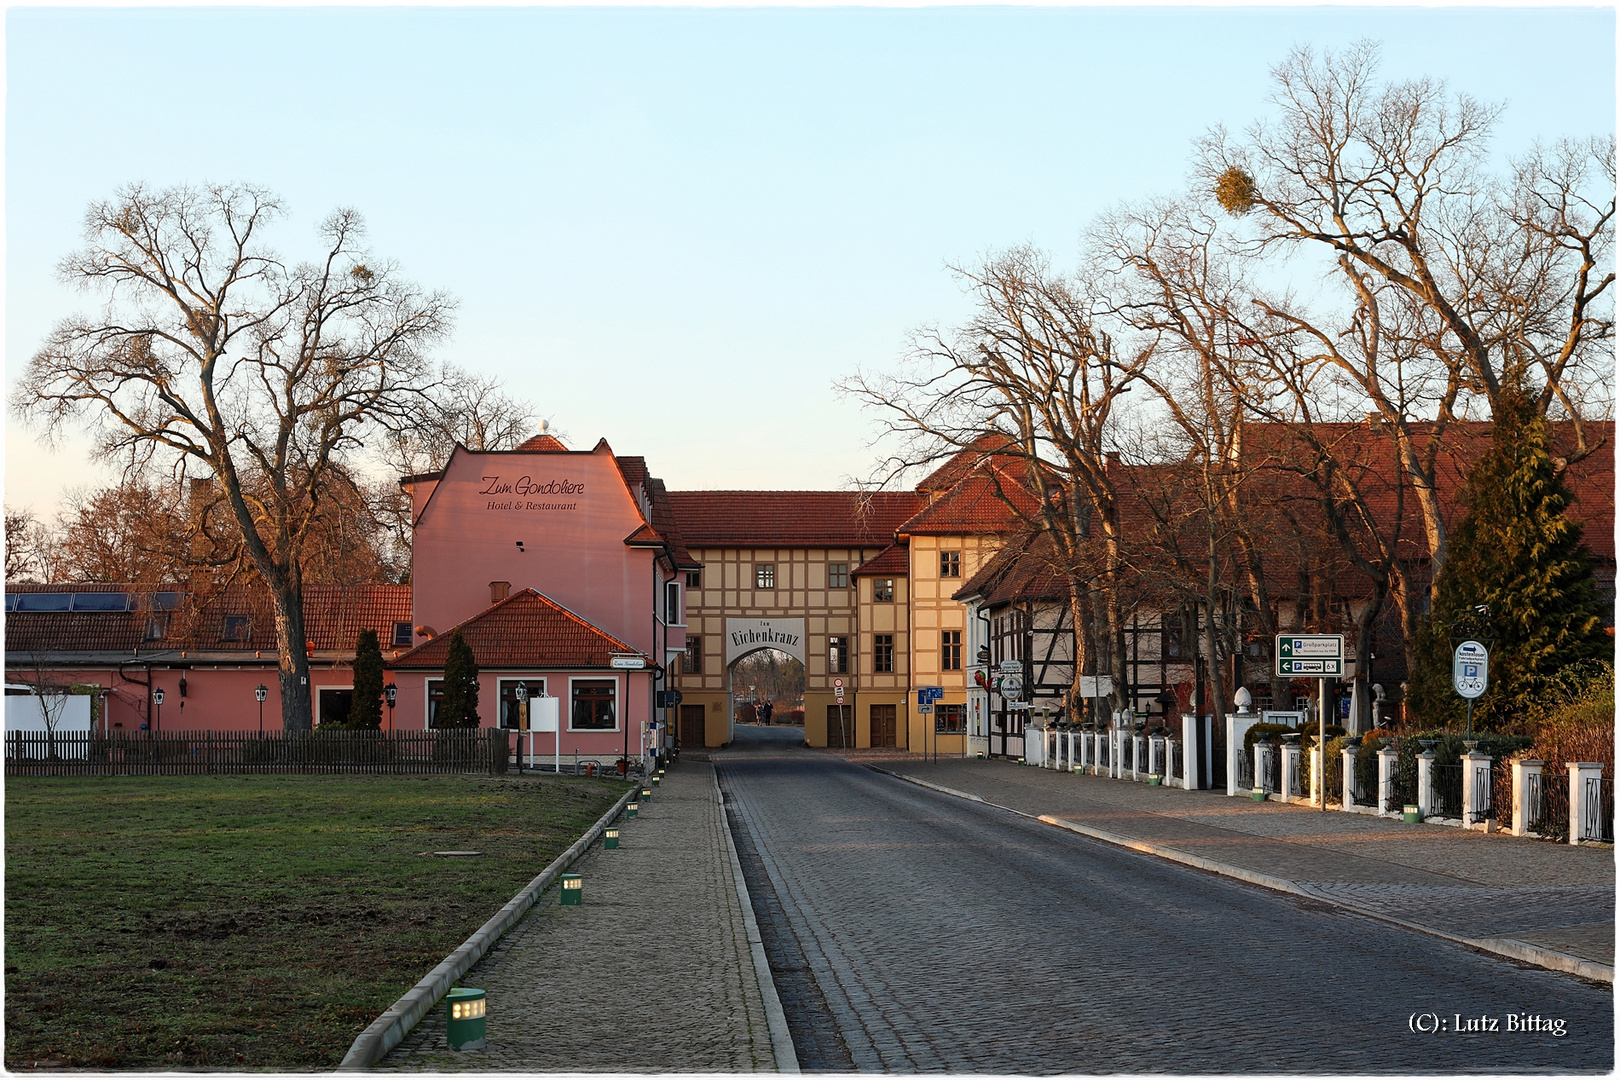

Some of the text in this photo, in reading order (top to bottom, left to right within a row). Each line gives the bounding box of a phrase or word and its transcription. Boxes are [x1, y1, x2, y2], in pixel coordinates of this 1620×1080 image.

[479, 475, 585, 497] Zum Gondoliere
[487, 501, 577, 511] Hotel & Restaurant
[731, 628, 799, 646] Eichenkranz
